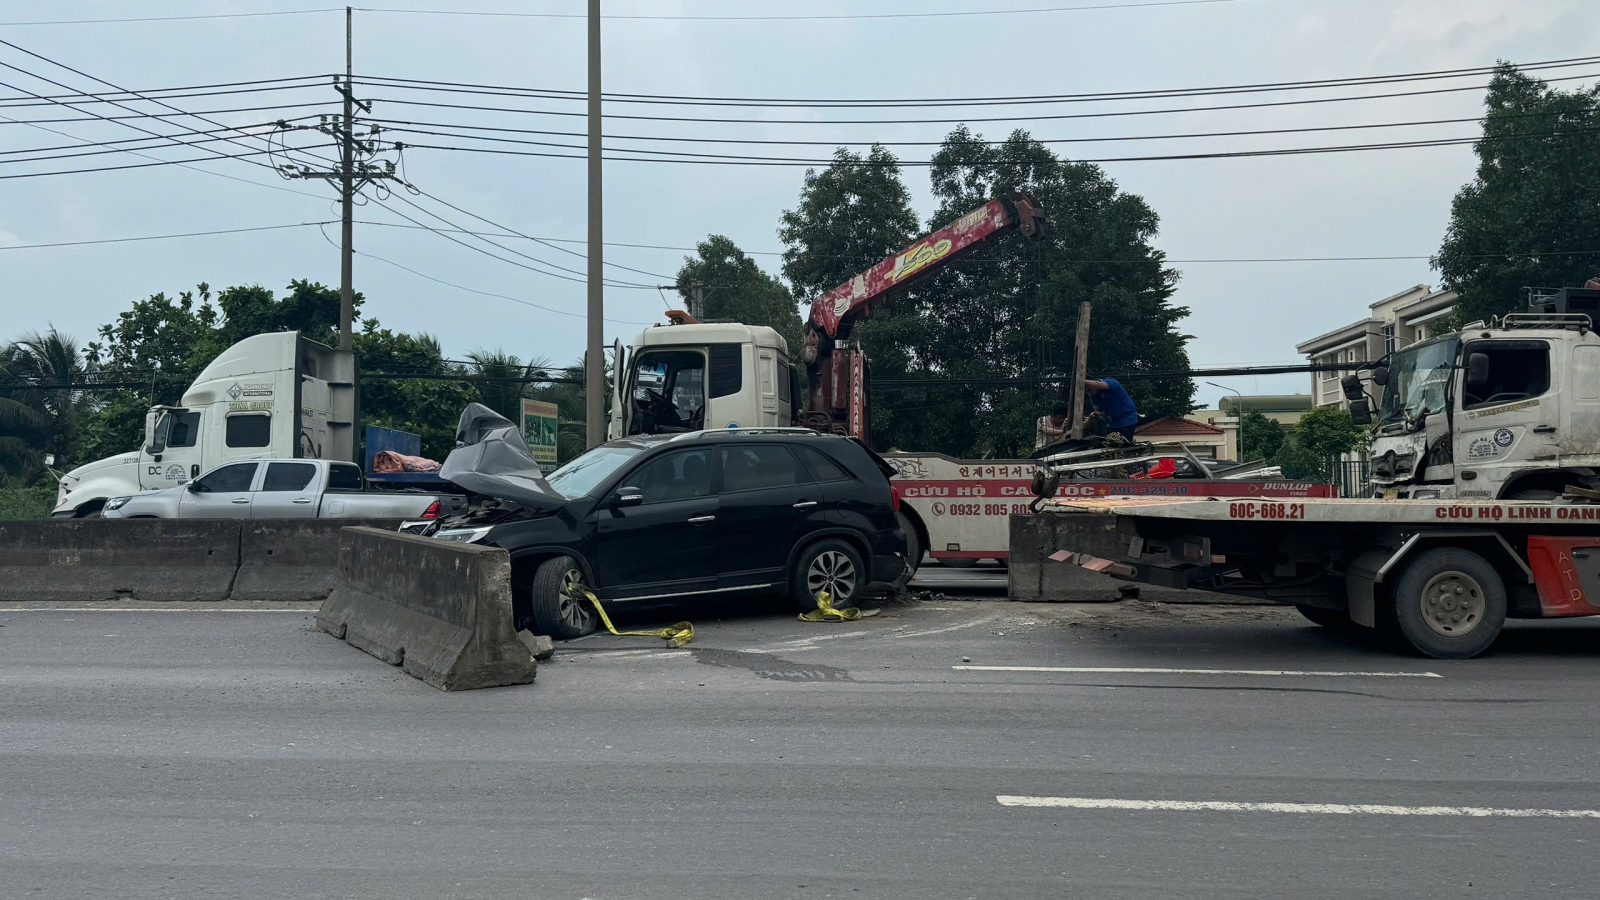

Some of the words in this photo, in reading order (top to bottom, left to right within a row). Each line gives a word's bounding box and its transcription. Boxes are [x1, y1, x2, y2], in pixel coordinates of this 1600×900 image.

[148, 466, 162, 475] DC
[905, 485, 949, 497] CỨU
[957, 484, 986, 498] HỘ
[1000, 486, 1038, 496] CA
[1109, 485, 1189, 495] 29C-329.39
[1263, 482, 1313, 490] DUNLOP
[950, 503, 981, 516] 0932
[984, 503, 1008, 516] 805
[1229, 502, 1305, 519] 60C-668.21
[1435, 505, 1473, 519] CỨU
[1478, 504, 1503, 520] HỘ
[1508, 507, 1552, 519] LINH
